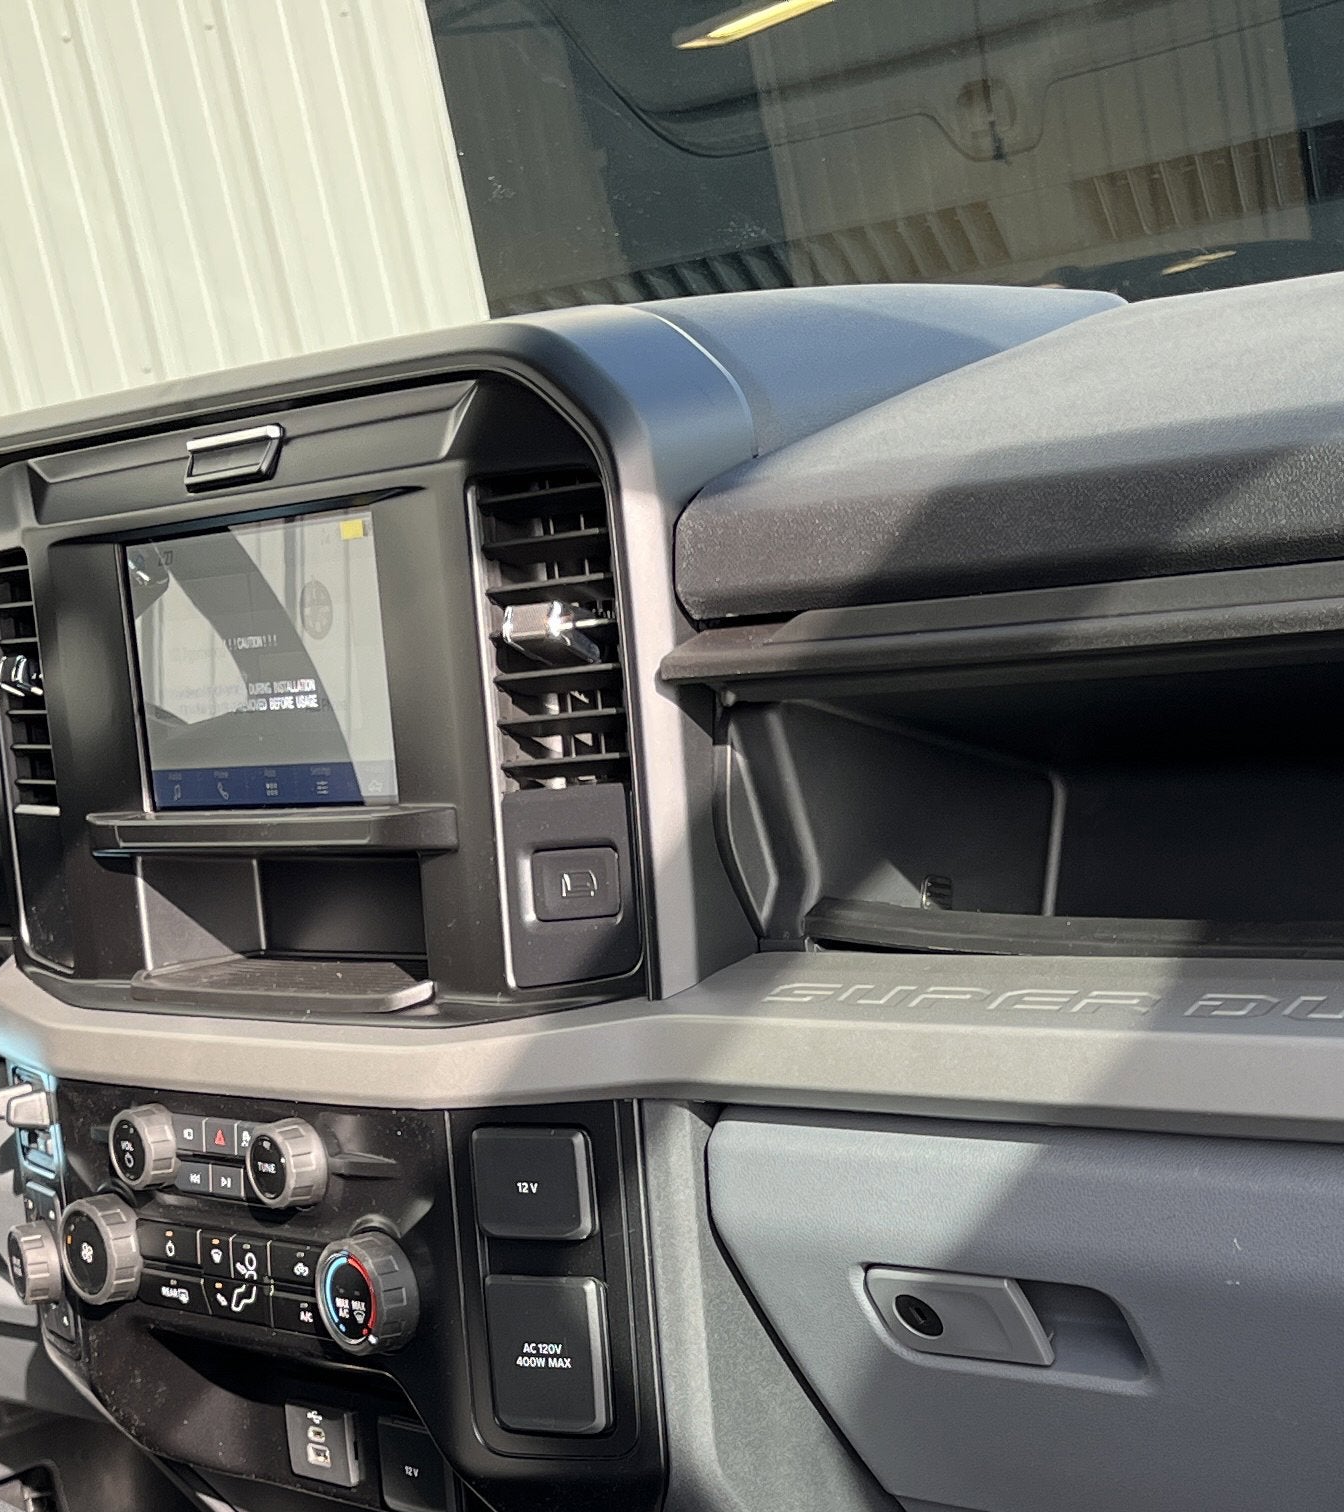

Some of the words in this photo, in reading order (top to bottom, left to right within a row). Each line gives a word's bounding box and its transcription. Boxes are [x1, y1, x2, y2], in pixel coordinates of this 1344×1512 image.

[269, 695, 295, 711] BEFORE
[295, 694, 319, 709] USAGE
[761, 982, 1163, 1015] SUPER
[257, 1161, 276, 1174] TUNE
[351, 1299, 366, 1311] MAX
[522, 1342, 537, 1354] AC
[537, 1343, 562, 1355] 120V
[516, 1355, 546, 1368] 400W
[548, 1357, 572, 1369] MAX
